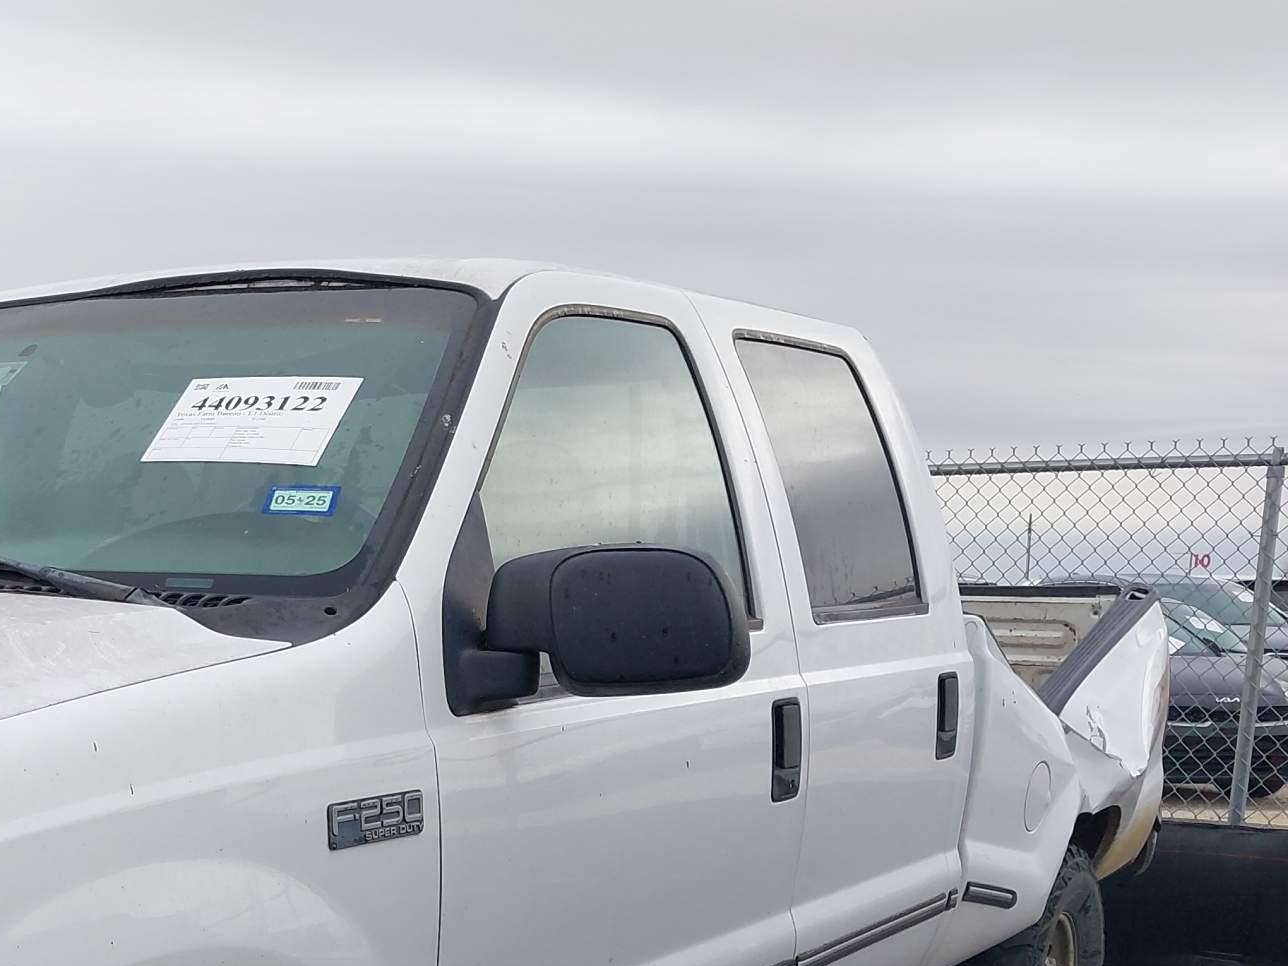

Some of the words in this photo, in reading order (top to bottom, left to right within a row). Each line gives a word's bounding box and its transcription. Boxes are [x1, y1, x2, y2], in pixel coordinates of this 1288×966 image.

[192, 395, 328, 411] 44093122
[365, 828, 398, 841] SUPER
[399, 821, 424, 834] DUTY
